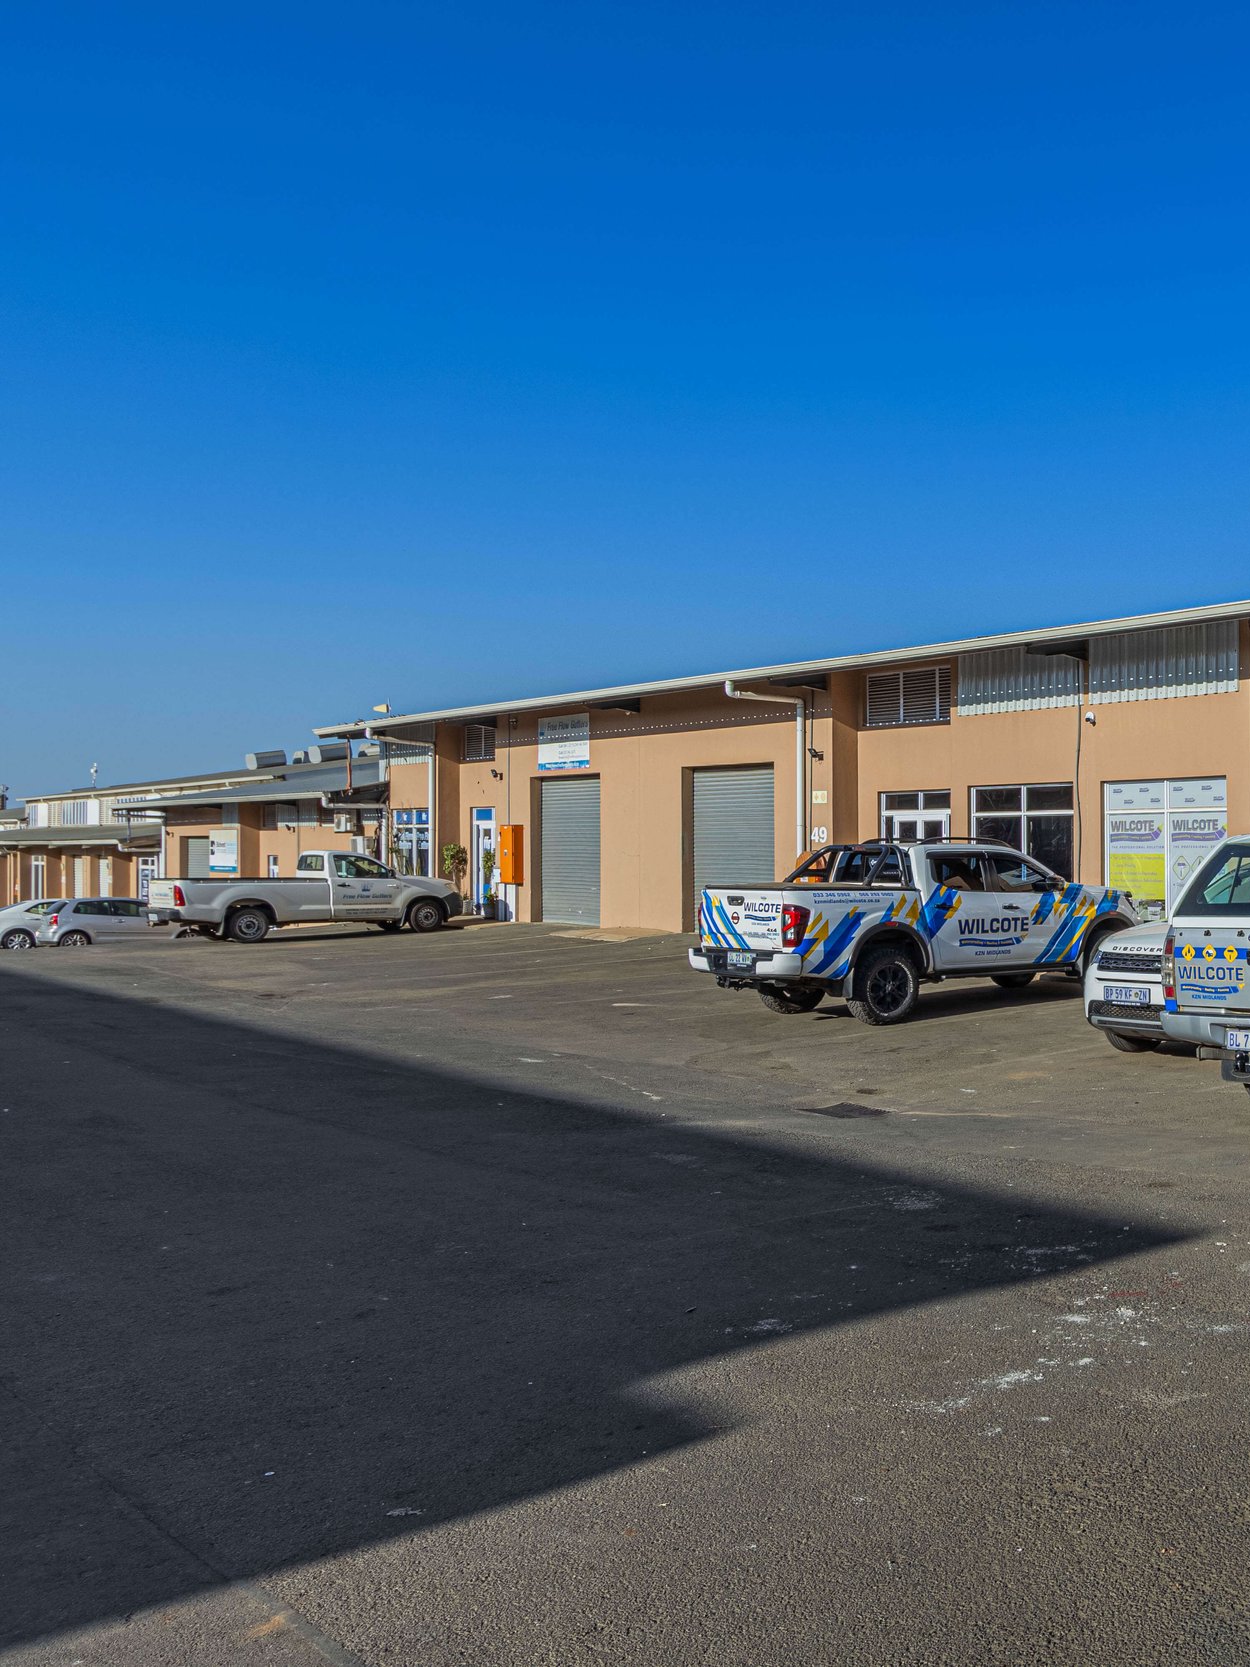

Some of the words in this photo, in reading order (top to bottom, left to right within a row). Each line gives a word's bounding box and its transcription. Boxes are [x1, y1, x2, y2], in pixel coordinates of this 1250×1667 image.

[1111, 820, 1155, 832] WILCOTE
[1172, 819, 1219, 832] WILCOTE
[811, 826, 828, 843] 49
[743, 902, 782, 913] WILCOTE
[958, 916, 1029, 935] WILCOTE
[1178, 965, 1244, 981] WILCOTE
[1105, 988, 1114, 999] BP
[1115, 988, 1123, 999] 59
[1138, 990, 1147, 1001] ZN
[1229, 1033, 1240, 1047] BL
